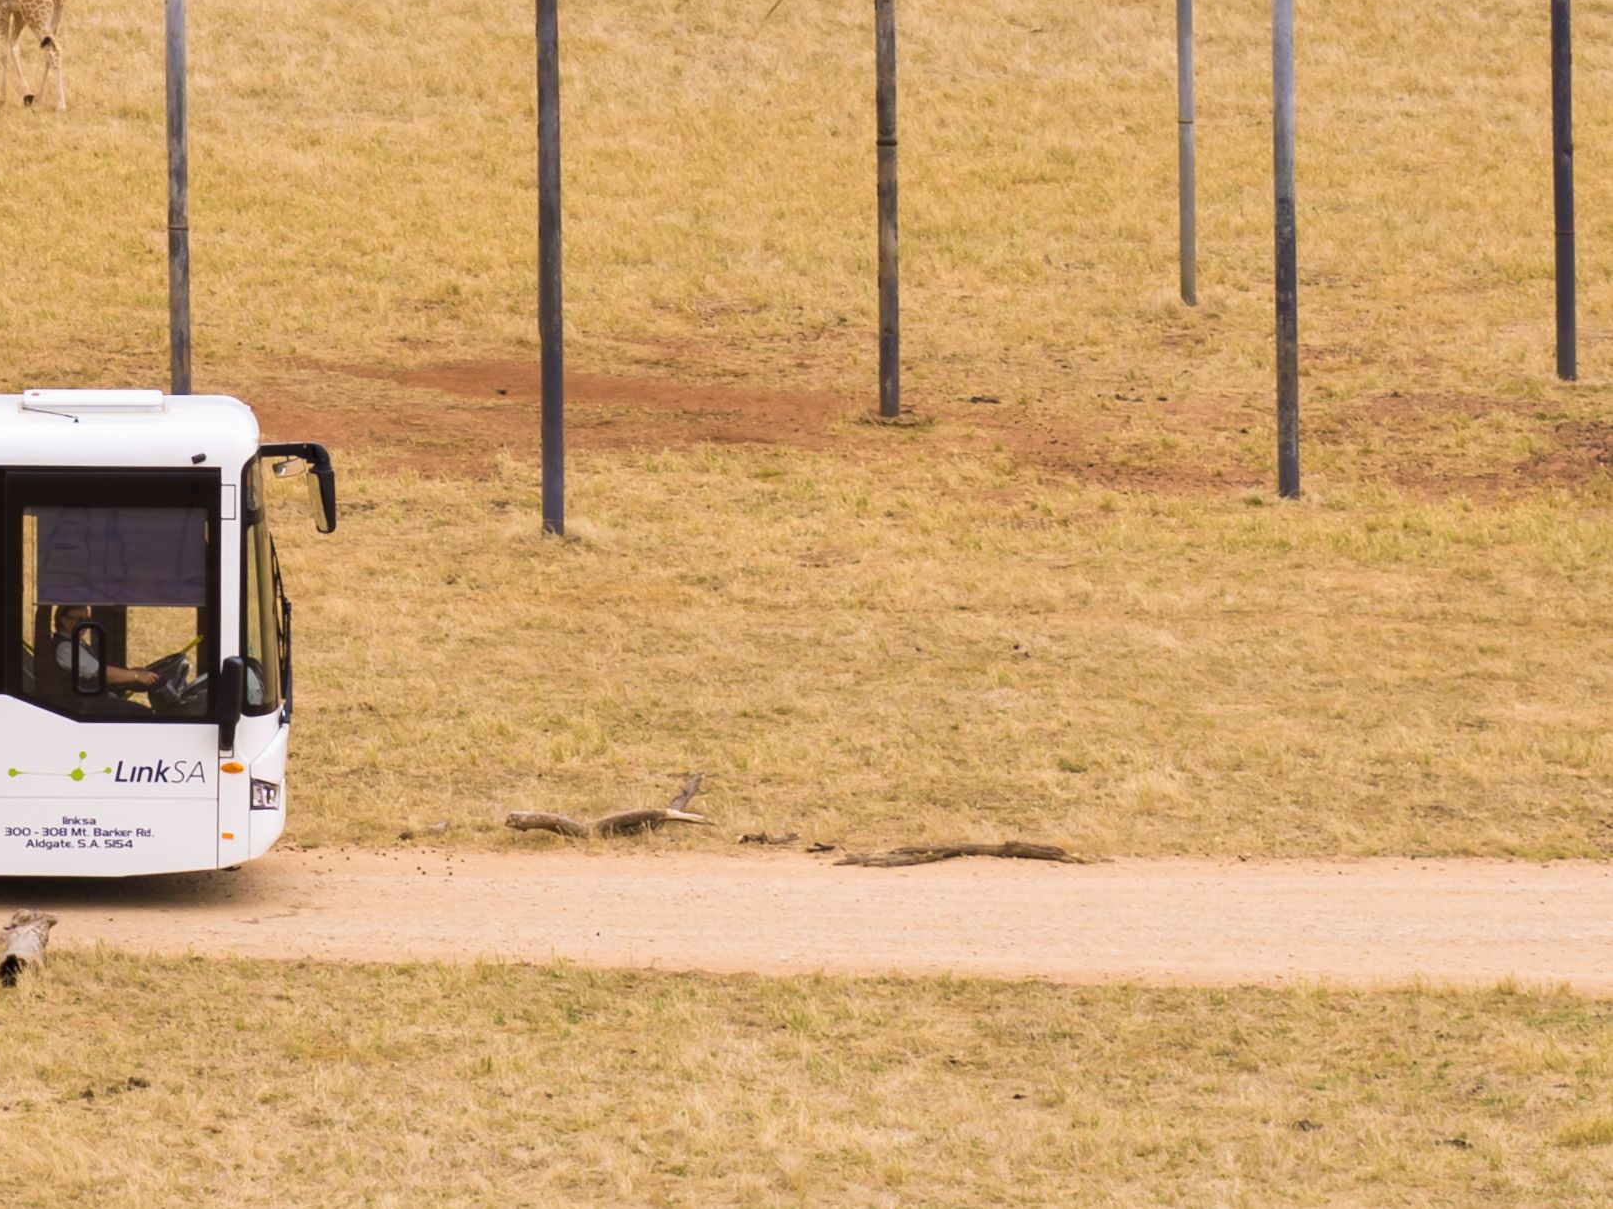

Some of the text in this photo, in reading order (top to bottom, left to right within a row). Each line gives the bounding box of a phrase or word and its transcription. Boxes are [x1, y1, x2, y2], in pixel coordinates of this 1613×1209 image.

[114, 759, 206, 783] LinkSA
[62, 816, 97, 825] linksa
[5, 827, 31, 836] 300
[42, 827, 67, 836] 308
[93, 827, 132, 837] Barker
[104, 839, 134, 849] 5154
